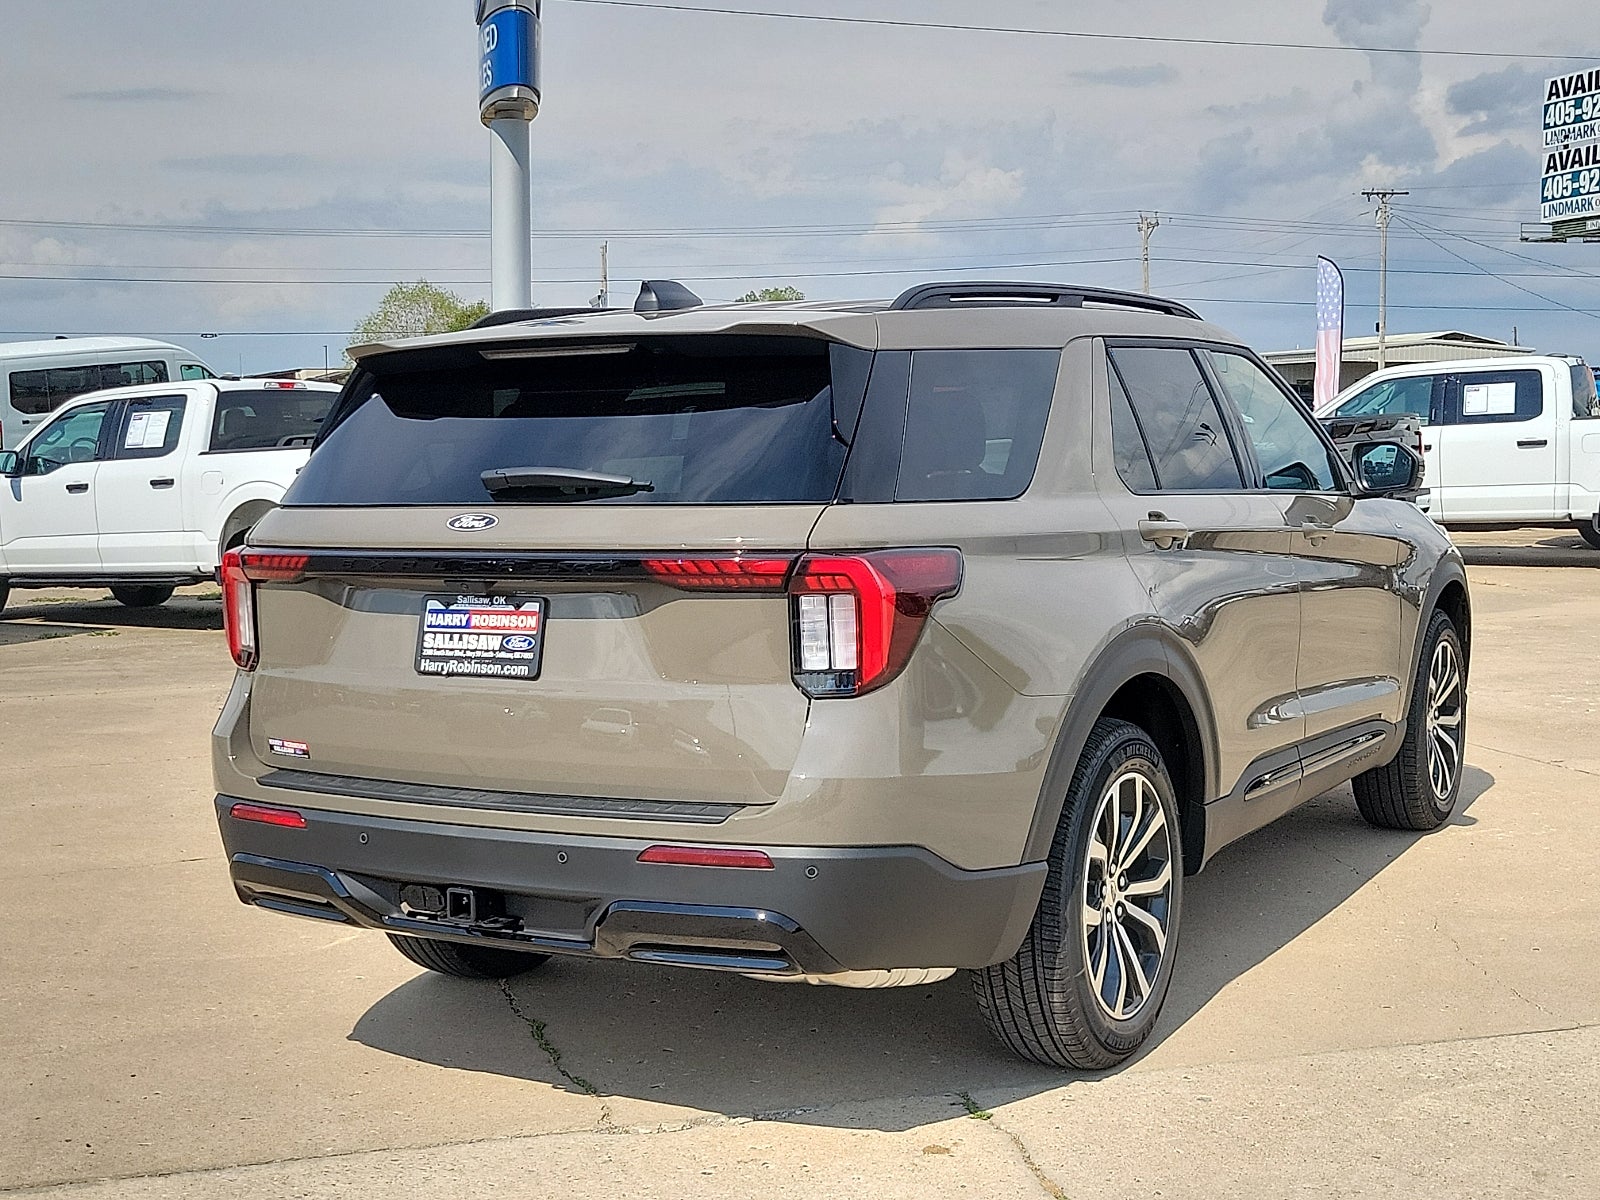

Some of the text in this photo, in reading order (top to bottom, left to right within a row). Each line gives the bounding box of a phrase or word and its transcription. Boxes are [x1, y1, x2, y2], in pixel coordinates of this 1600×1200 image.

[1546, 70, 1600, 101] AVAIL
[1545, 94, 1600, 127] 405-92
[1544, 144, 1600, 175] AVAIL
[1543, 168, 1600, 200] 405-92
[1543, 199, 1594, 219] LINDMARK
[457, 595, 507, 605] Sallisaw, OK
[427, 613, 537, 628] HARRY ROBINSON
[423, 632, 503, 651] SALLISAW
[420, 658, 529, 676] HarryRobinson.com
[1126, 744, 1159, 766] MICHELIN
